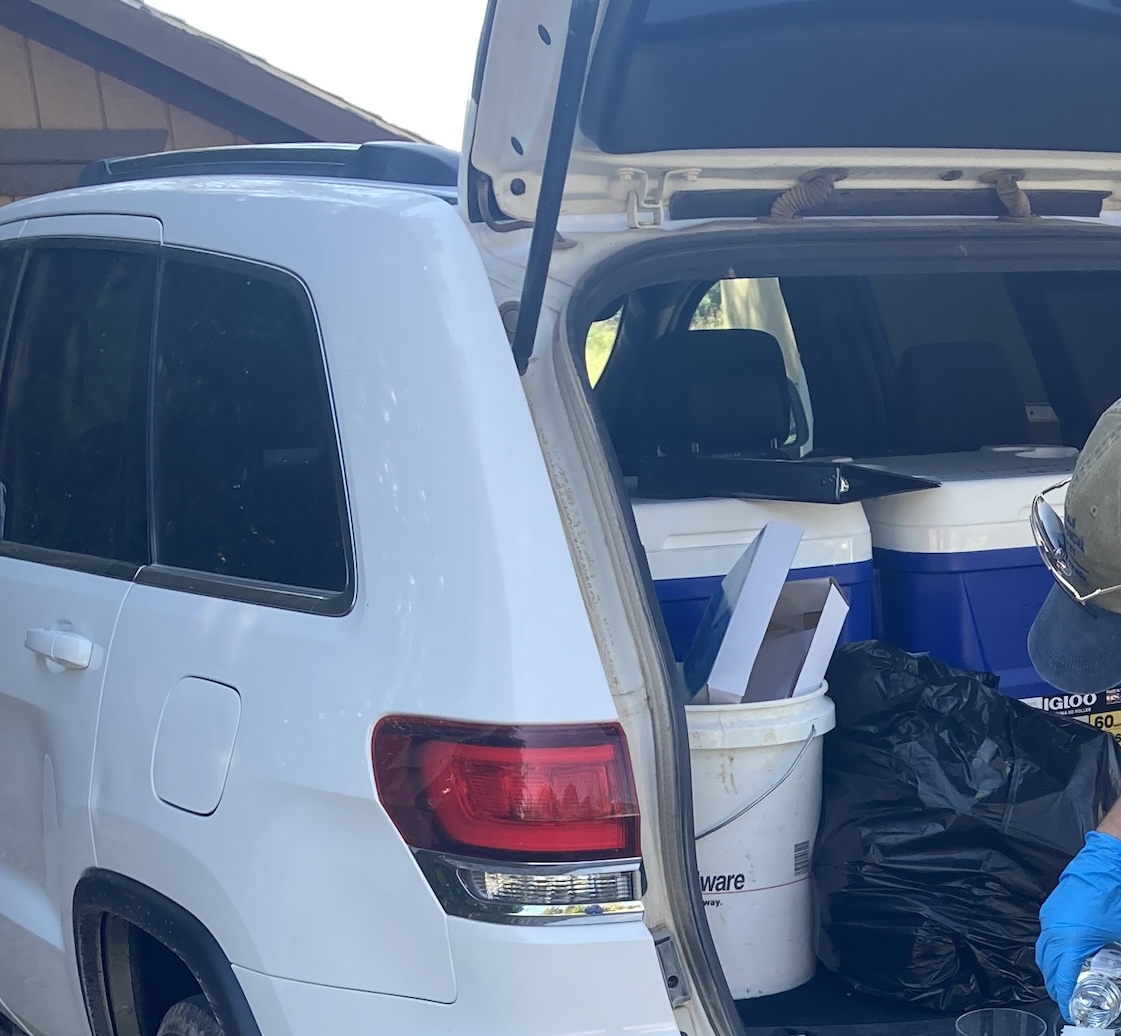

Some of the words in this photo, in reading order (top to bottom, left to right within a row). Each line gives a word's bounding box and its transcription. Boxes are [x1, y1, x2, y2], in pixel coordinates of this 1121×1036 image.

[1043, 693, 1098, 711] IGLOO
[1094, 714, 1114, 729] 60
[699, 872, 745, 892] ware
